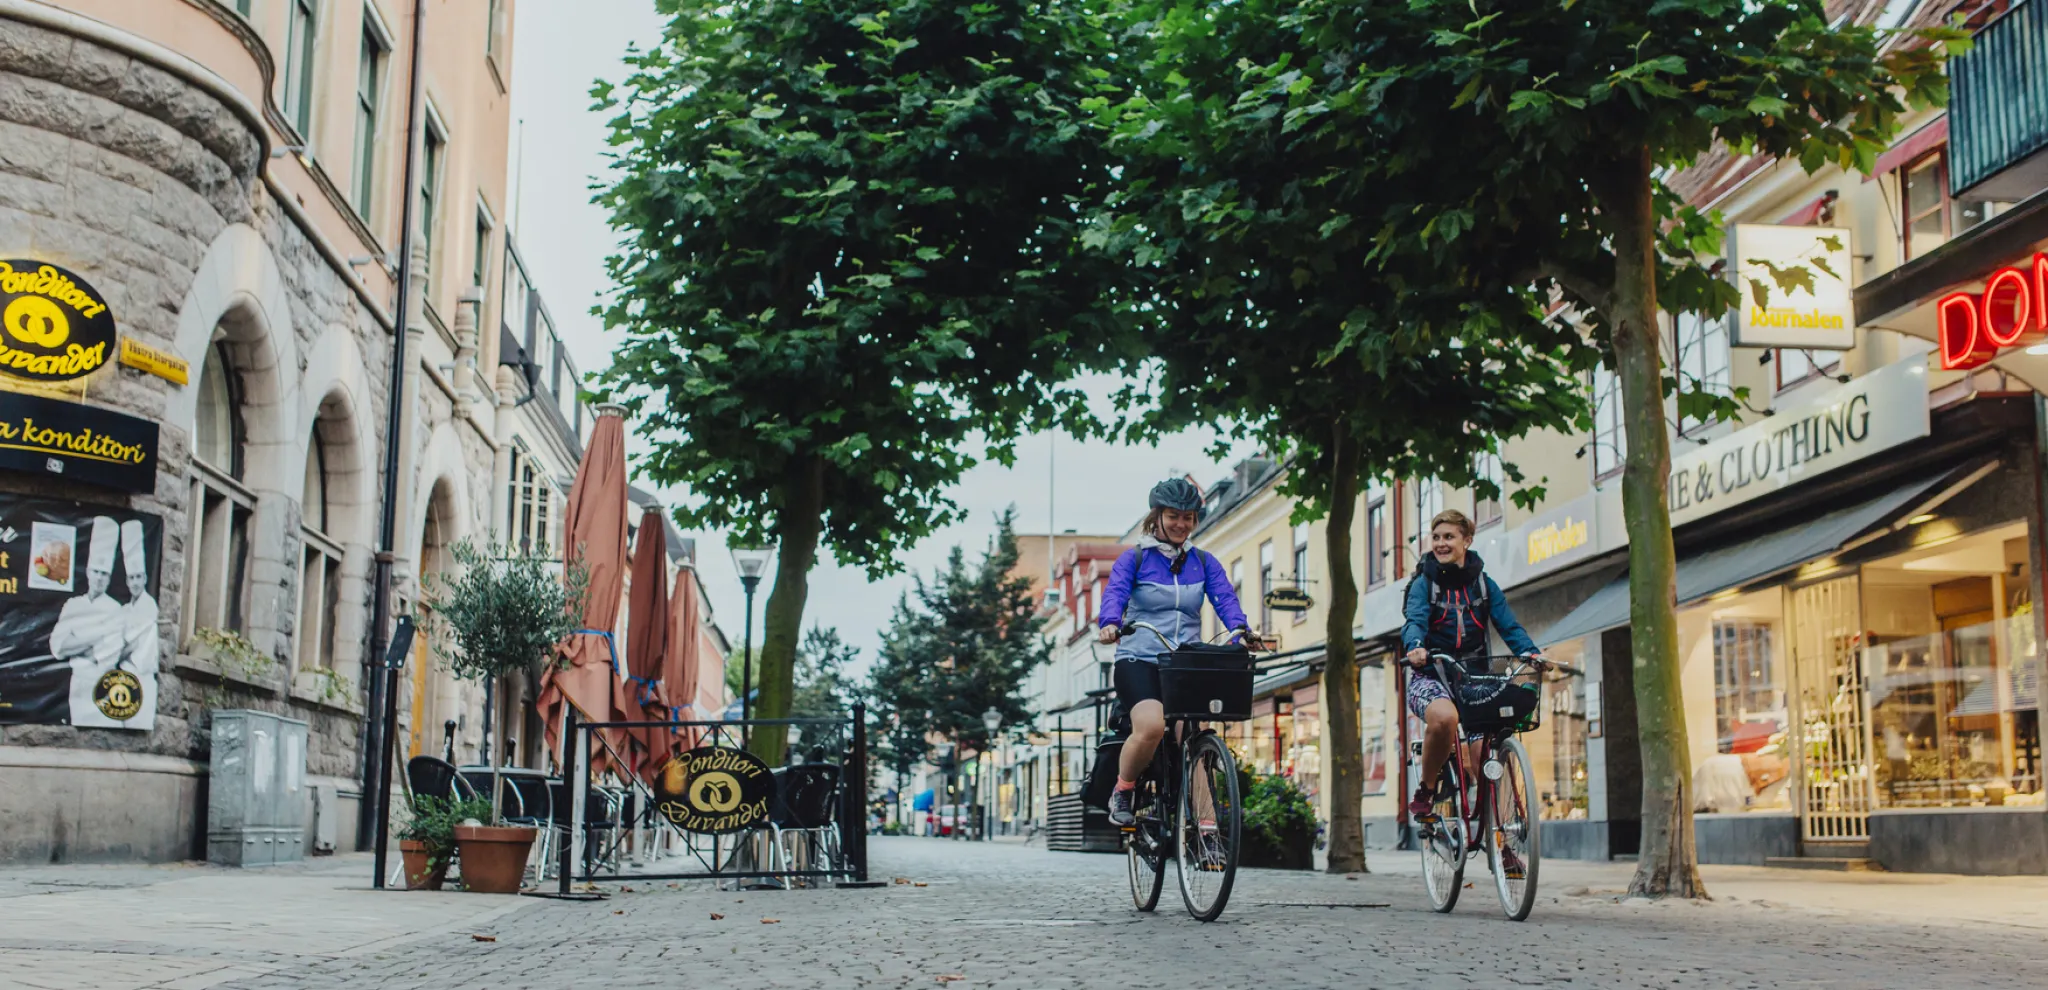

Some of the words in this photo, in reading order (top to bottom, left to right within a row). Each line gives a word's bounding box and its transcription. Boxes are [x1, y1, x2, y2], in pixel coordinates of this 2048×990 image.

[1750, 305, 1844, 330] Journalen
[22, 416, 146, 465] konditori
[1695, 461, 1714, 504] &
[1720, 392, 1871, 495] CLOTHING
[660, 748, 767, 779] Conditori
[660, 797, 768, 831] Duvander
